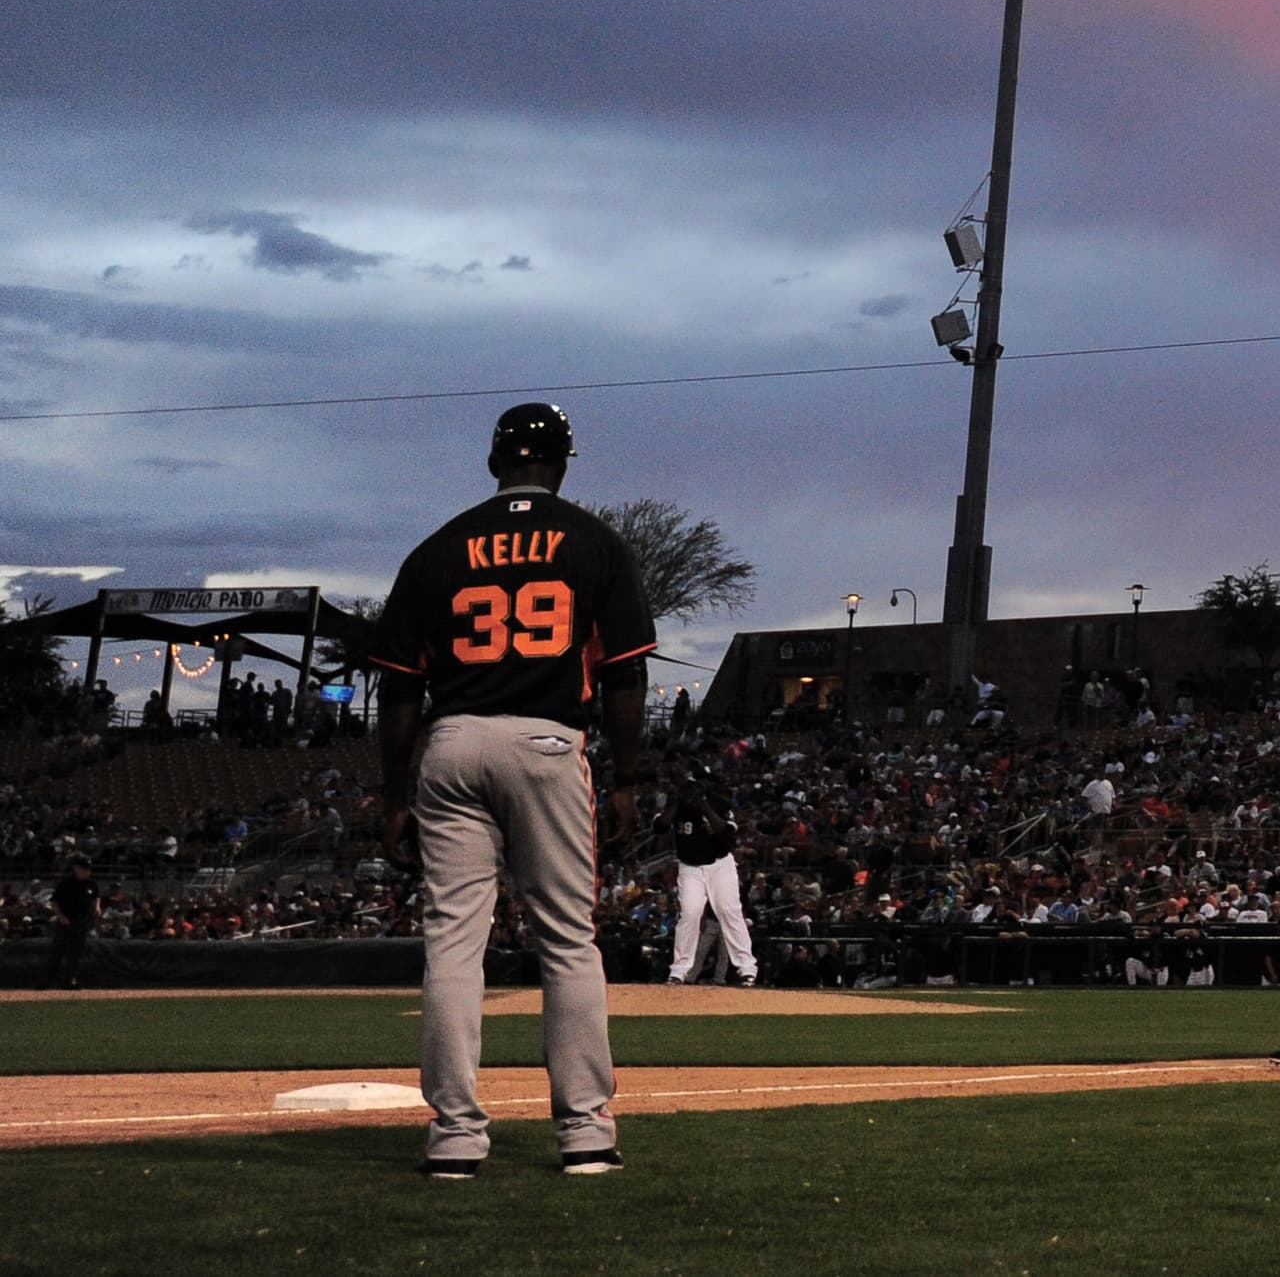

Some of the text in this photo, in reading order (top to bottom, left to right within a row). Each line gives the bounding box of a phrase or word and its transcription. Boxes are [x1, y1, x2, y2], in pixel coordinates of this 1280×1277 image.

[467, 529, 566, 570] KELLY
[219, 591, 264, 608] PATIO
[451, 579, 576, 665] 39
